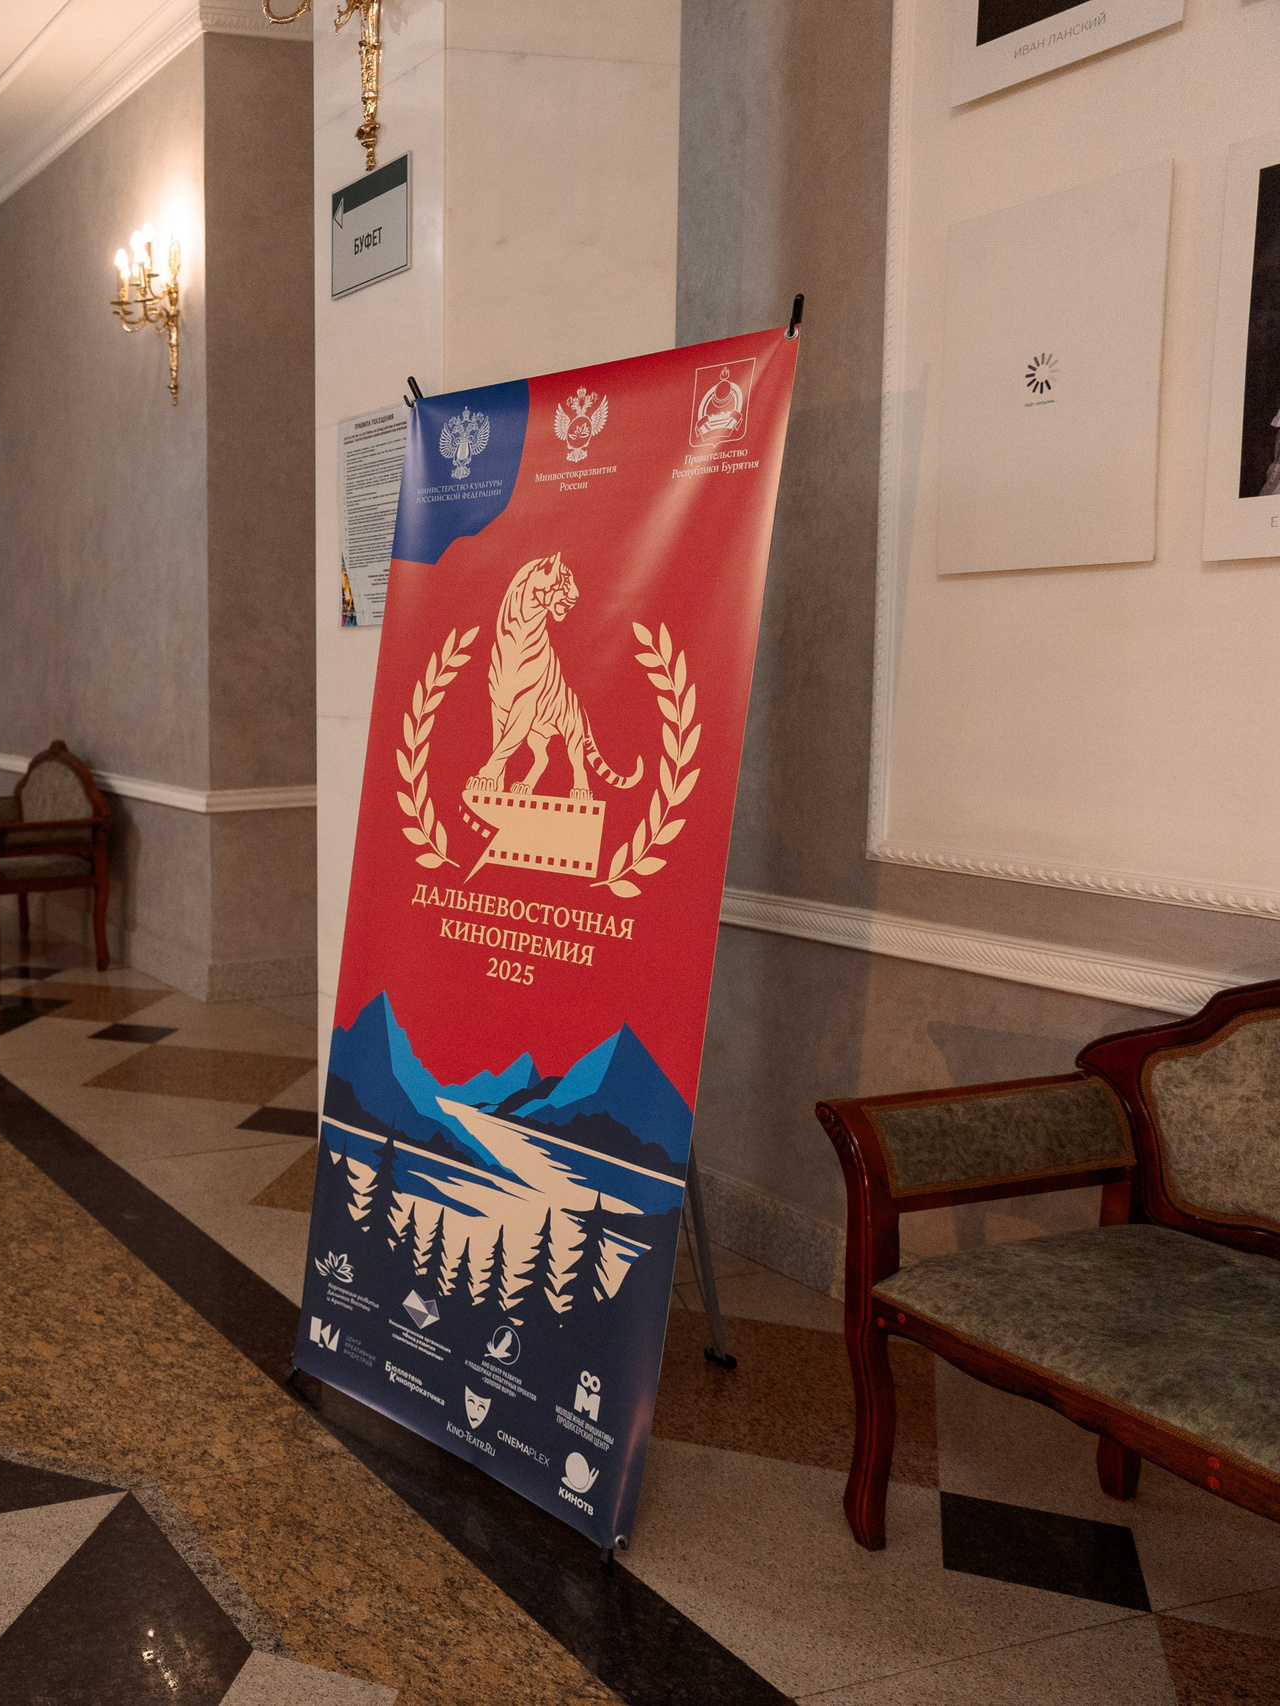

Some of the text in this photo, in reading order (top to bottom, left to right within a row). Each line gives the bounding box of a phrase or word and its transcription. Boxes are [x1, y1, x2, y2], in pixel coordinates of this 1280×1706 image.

[1014, 12, 1106, 58] ИВАН ЛАНСКИЙ
[354, 227, 382, 255] БУФЕТ
[672, 460, 759, 479] Республики Бурятия
[684, 449, 748, 466] Правительство
[417, 479, 503, 495] МИНИСТЕРСТВО КУЛЬТУРЫ
[535, 465, 617, 483] Минвостокразвития
[560, 482, 588, 492] России
[416, 489, 502, 504] РОССИЙСКОЙ ФЕДЕРАЦИИ
[411, 883, 635, 941] ДАЛЬНЕВОСТОЧНАЯ
[439, 917, 595, 967] КИНОПРЕМИЯ
[486, 957, 535, 986] 2025
[344, 1342, 376, 1361] КРЕАТИВНЫХ
[345, 1334, 362, 1346] ЦЕНТР
[343, 1348, 373, 1367] ИНДУСТРИЙ
[384, 1360, 423, 1386] Бюллетень
[389, 1371, 445, 1406] Кинопрокатчика
[555, 1405, 614, 1446] МОЛОДЁЖНЫЕ ИНИЦИАТИВЫ
[556, 1414, 610, 1452] ПРОДЮСЕРСКИЙ ЦЕНТР
[496, 1430, 551, 1467] CINEMAPLEX
[558, 1486, 594, 1516] КИНОТВ
